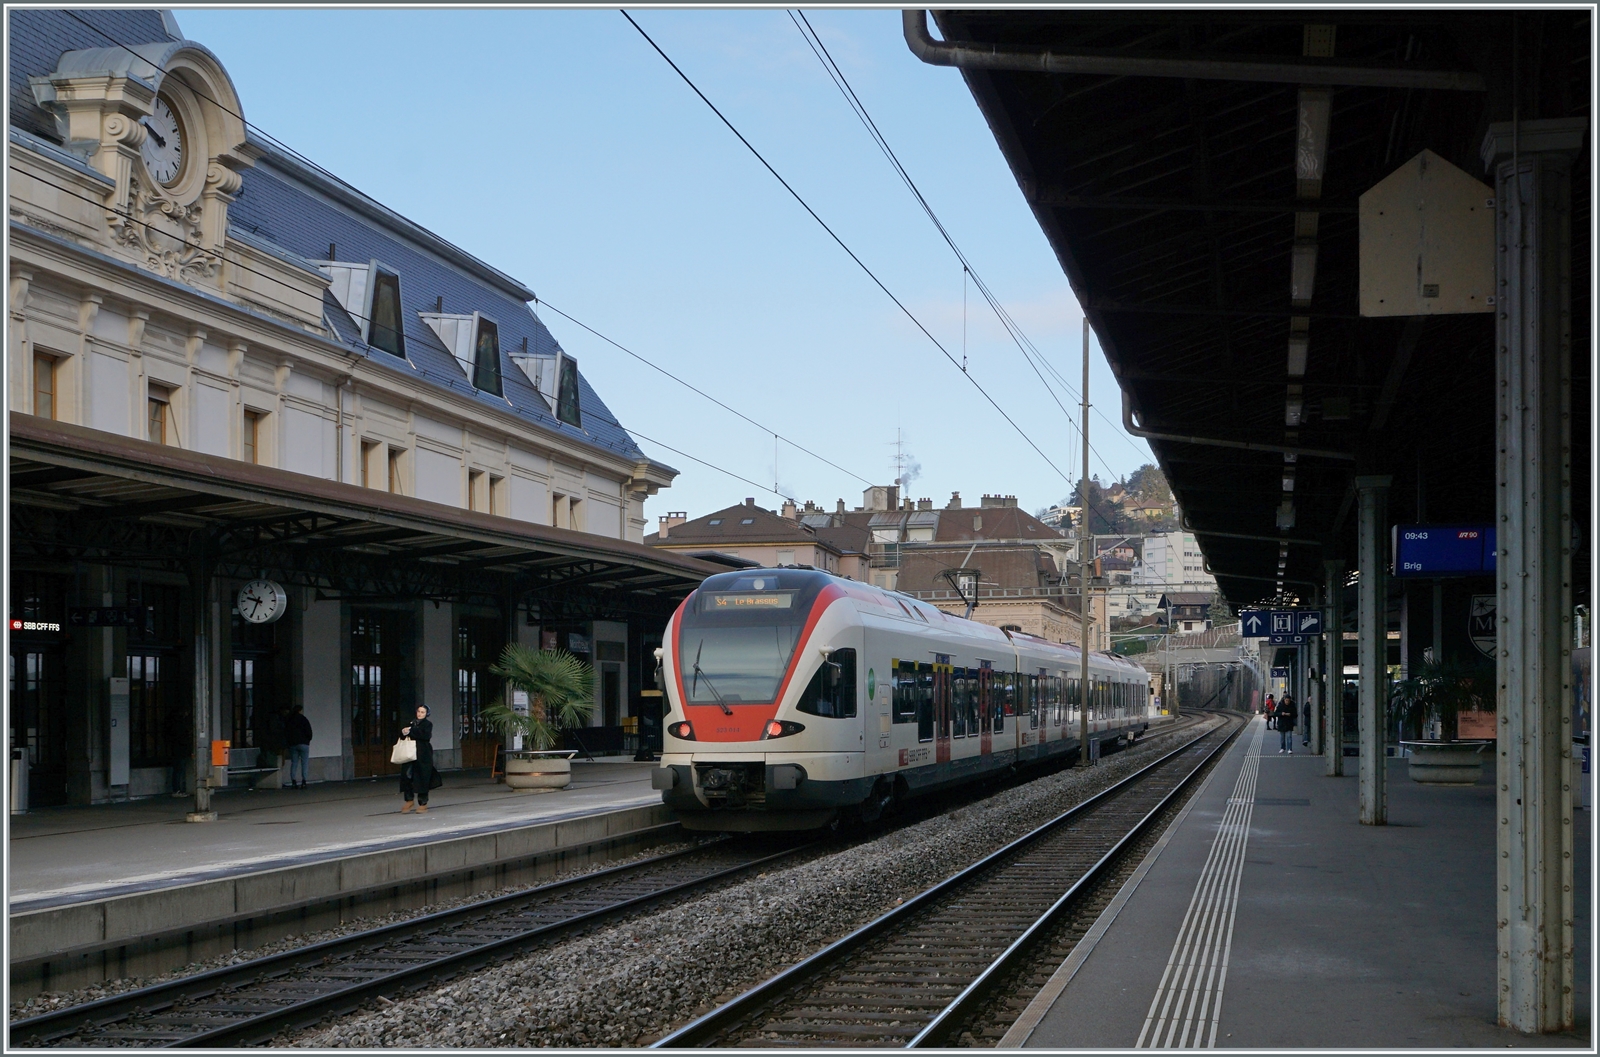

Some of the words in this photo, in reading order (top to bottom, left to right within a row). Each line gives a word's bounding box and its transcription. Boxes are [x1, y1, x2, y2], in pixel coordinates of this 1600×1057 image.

[1404, 532, 1428, 540] 09:43
[1403, 562, 1422, 571] Brig
[716, 598, 727, 606] S4
[746, 597, 779, 605] Brassus
[23, 621, 37, 631] SBB
[37, 622, 48, 631] CFF
[48, 623, 60, 632] FFS
